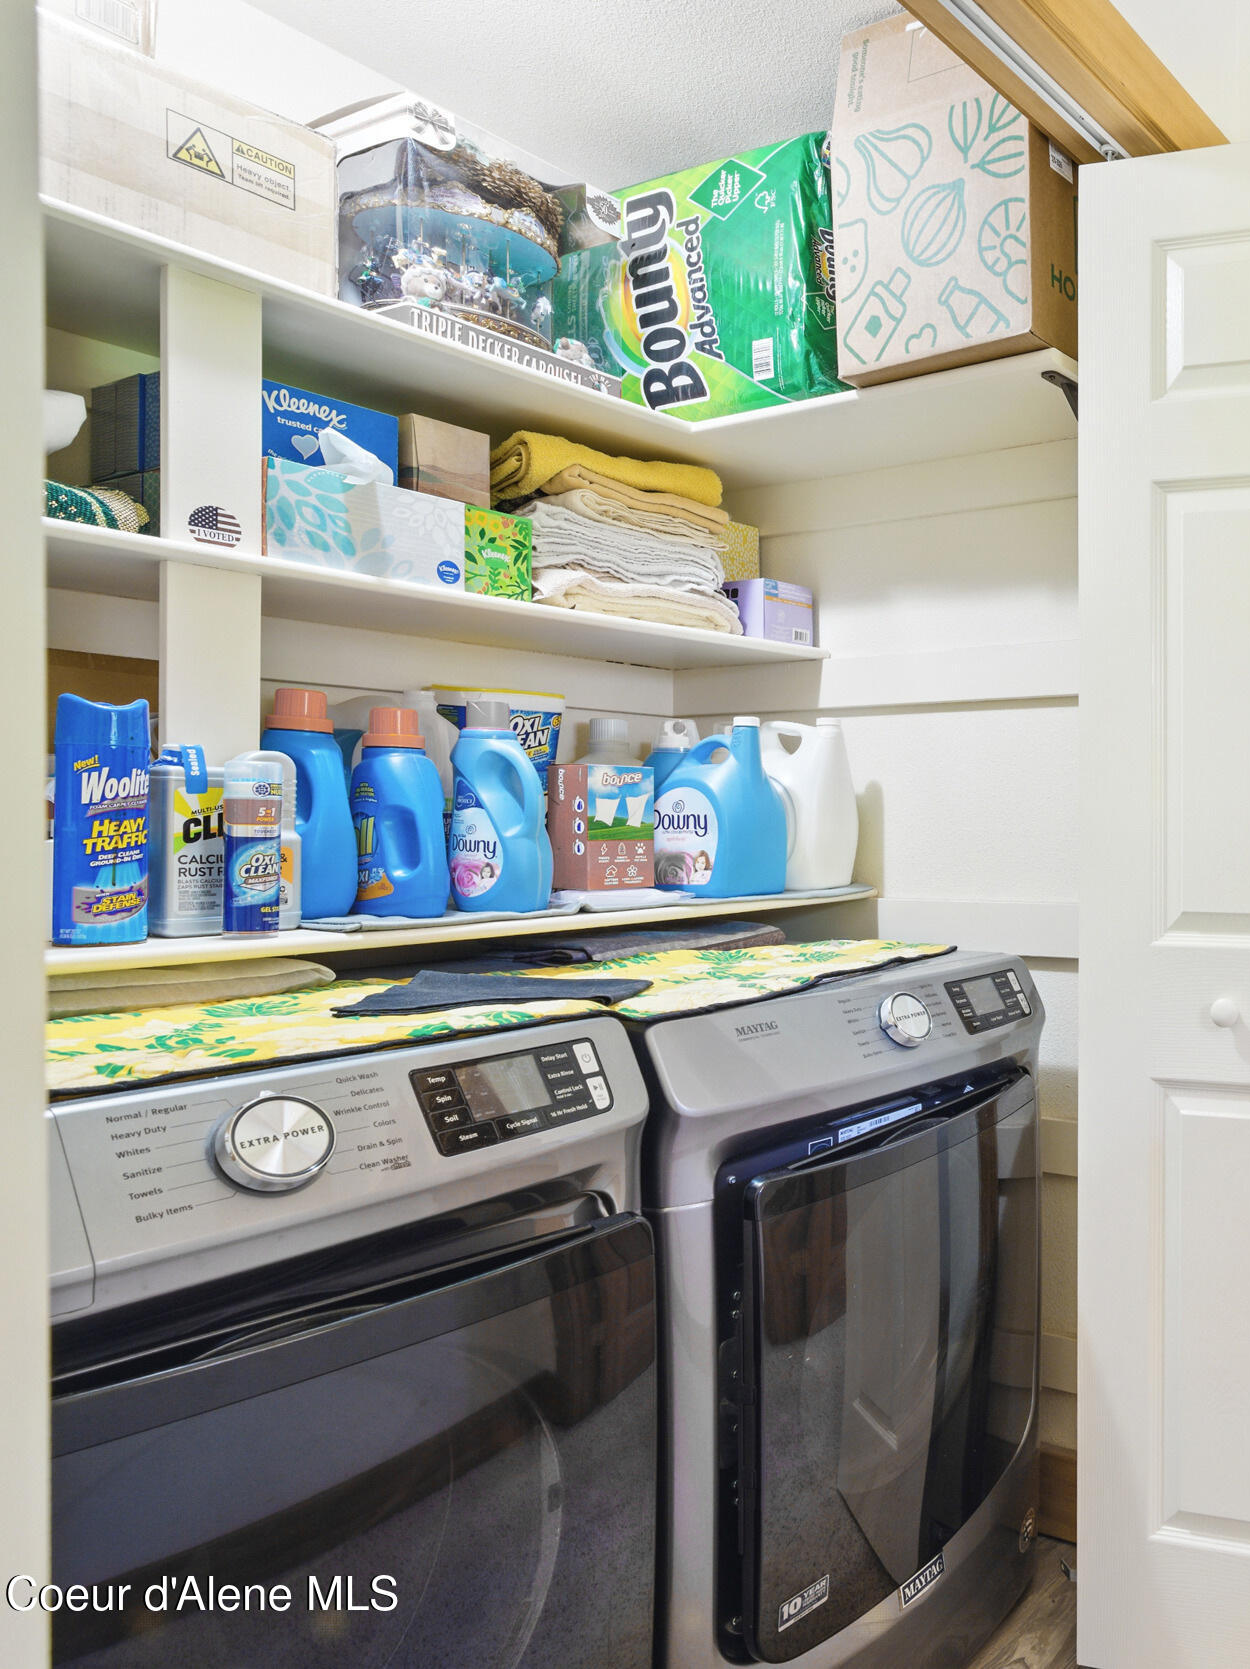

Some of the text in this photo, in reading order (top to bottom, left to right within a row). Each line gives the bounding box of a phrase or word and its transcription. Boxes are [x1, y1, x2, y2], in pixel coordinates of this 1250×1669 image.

[246, 148, 292, 175] CAUTION
[236, 163, 262, 180] Heavy
[718, 169, 727, 206] Quicker
[725, 173, 734, 204] Picker
[732, 170, 741, 202] Upper
[711, 189, 719, 208] The
[677, 214, 724, 361] Advanced
[619, 189, 709, 411] Bounty
[410, 307, 464, 347] TRIPLE
[468, 330, 521, 366] DECKER
[262, 388, 347, 428] Kleenex
[277, 415, 312, 432] trusted
[197, 528, 234, 542] I VOTED
[509, 714, 541, 737] OXI
[517, 727, 550, 751] EAN
[73, 755, 100, 772] New!
[186, 748, 200, 777] Sealed
[81, 767, 149, 804] Woolite
[558, 769, 566, 800] bounce
[602, 772, 642, 786] bounce
[191, 804, 224, 815] MULTI-US
[91, 816, 146, 838] HEAVY
[654, 810, 708, 838] Downy
[83, 829, 148, 855] TRAFFIC
[452, 833, 497, 860] Downy
[90, 856, 131, 867] GROUND-IN
[251, 853, 276, 867] OXI
[178, 866, 217, 878] RUST
[240, 863, 279, 878] CLEAN
[92, 898, 143, 914] DEFENSE
[101, 892, 137, 905] STAIN
[896, 1014, 911, 1022] EXTRA
[911, 1010, 926, 1018] POWER
[735, 1020, 779, 1038] MAYTAG
[335, 1071, 378, 1084] Quick Wash
[426, 1075, 446, 1084] Temp
[350, 1085, 385, 1098] Delicates
[435, 1095, 451, 1103] Spin
[105, 1103, 188, 1124] Normal / Regular
[333, 1099, 390, 1117] Wrinkle Control
[373, 1117, 396, 1128] Colors
[444, 1114, 459, 1123] Soil
[506, 1116, 538, 1130] Cycle Signal
[110, 1124, 167, 1141] Heavy Duty
[239, 1124, 325, 1150] EXTRA POWER
[459, 1132, 478, 1141] Steam
[115, 1146, 151, 1159] Whites
[357, 1141, 378, 1152] Drain
[386, 1136, 403, 1147] Spin
[359, 1160, 380, 1171] Clean
[381, 1153, 409, 1165] Washer
[122, 1165, 163, 1180] Sanitize
[128, 1187, 164, 1200] Towels
[134, 1203, 194, 1223] Bulky Items
[903, 1558, 943, 1602] MAYTAG
[782, 1596, 802, 1621] 10
[803, 1579, 827, 1598] YEAR
